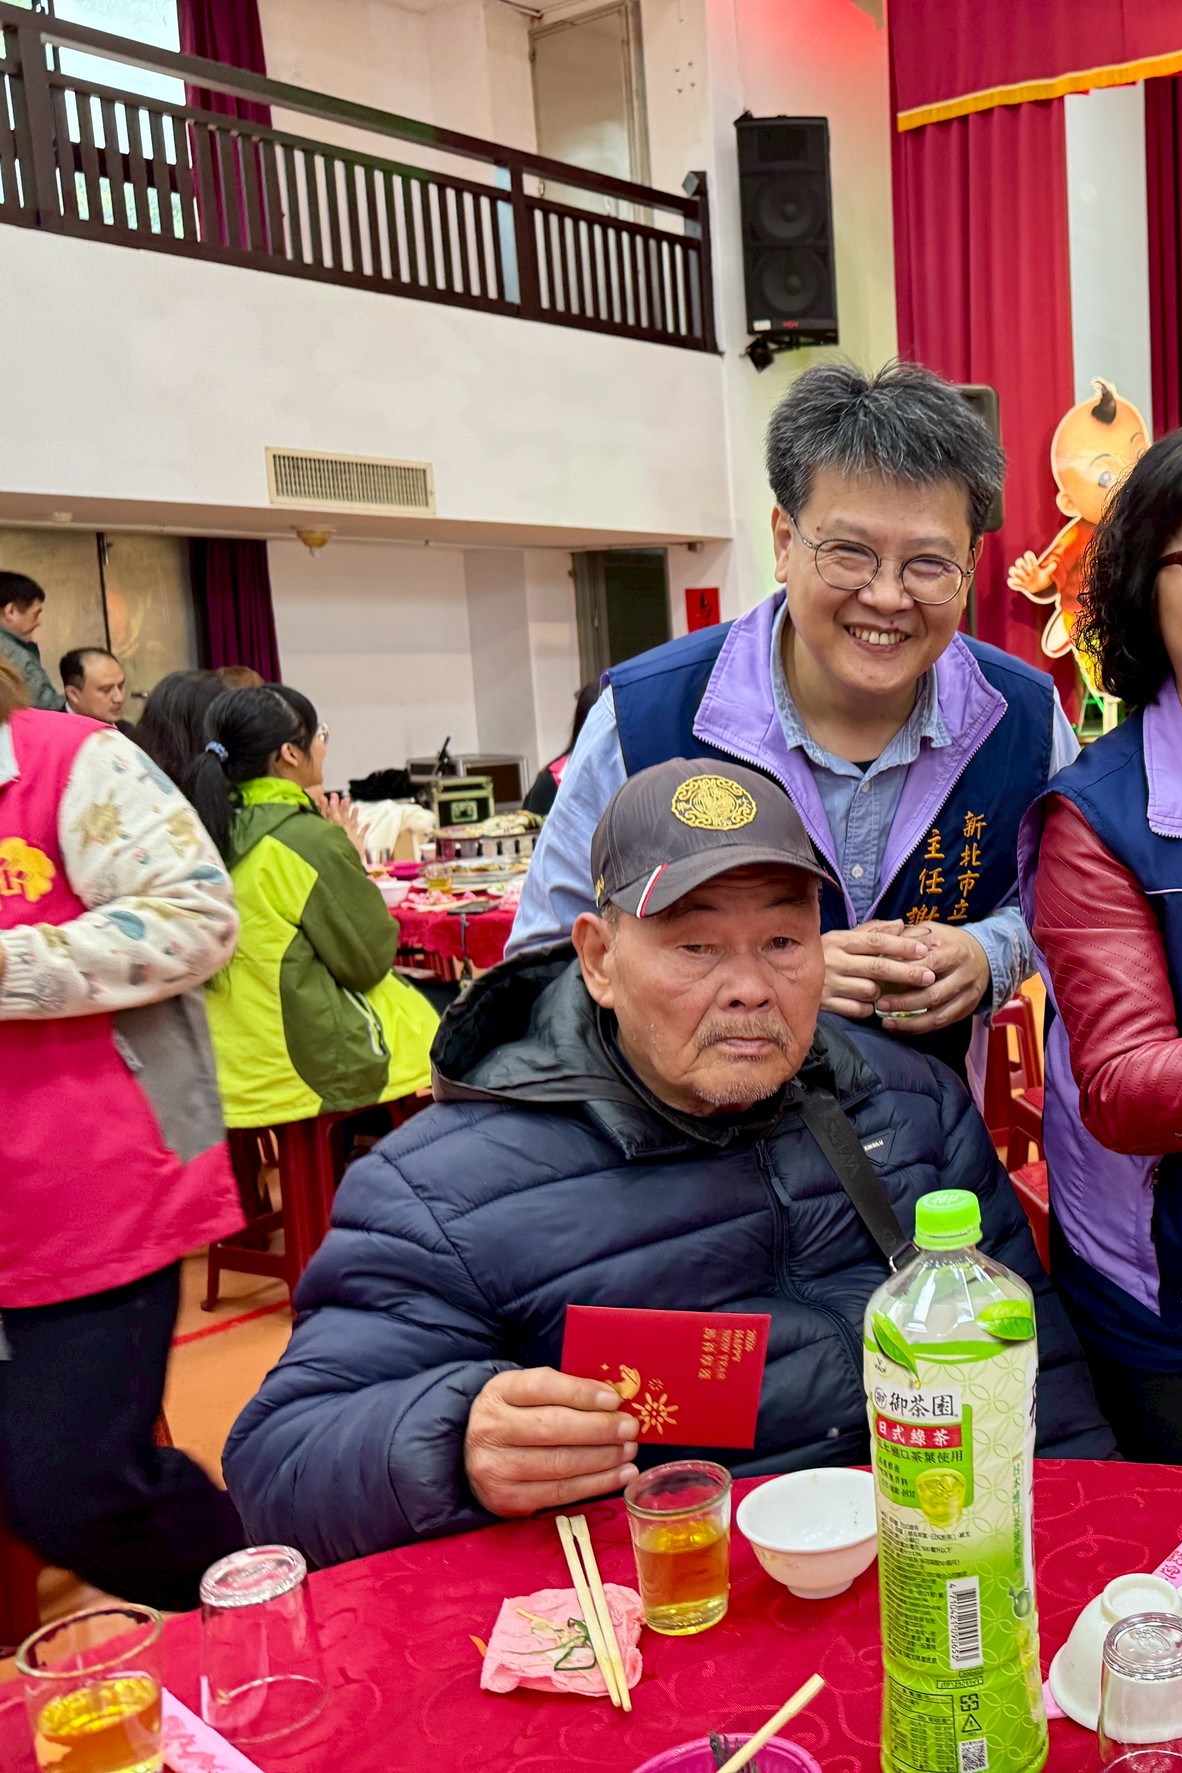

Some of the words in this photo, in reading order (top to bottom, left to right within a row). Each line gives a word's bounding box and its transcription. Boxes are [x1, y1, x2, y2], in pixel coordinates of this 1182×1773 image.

[947, 810, 988, 921] 新北市立
[889, 1391, 954, 1418] 御茶園
[878, 1420, 951, 1447] 日式綠茶
